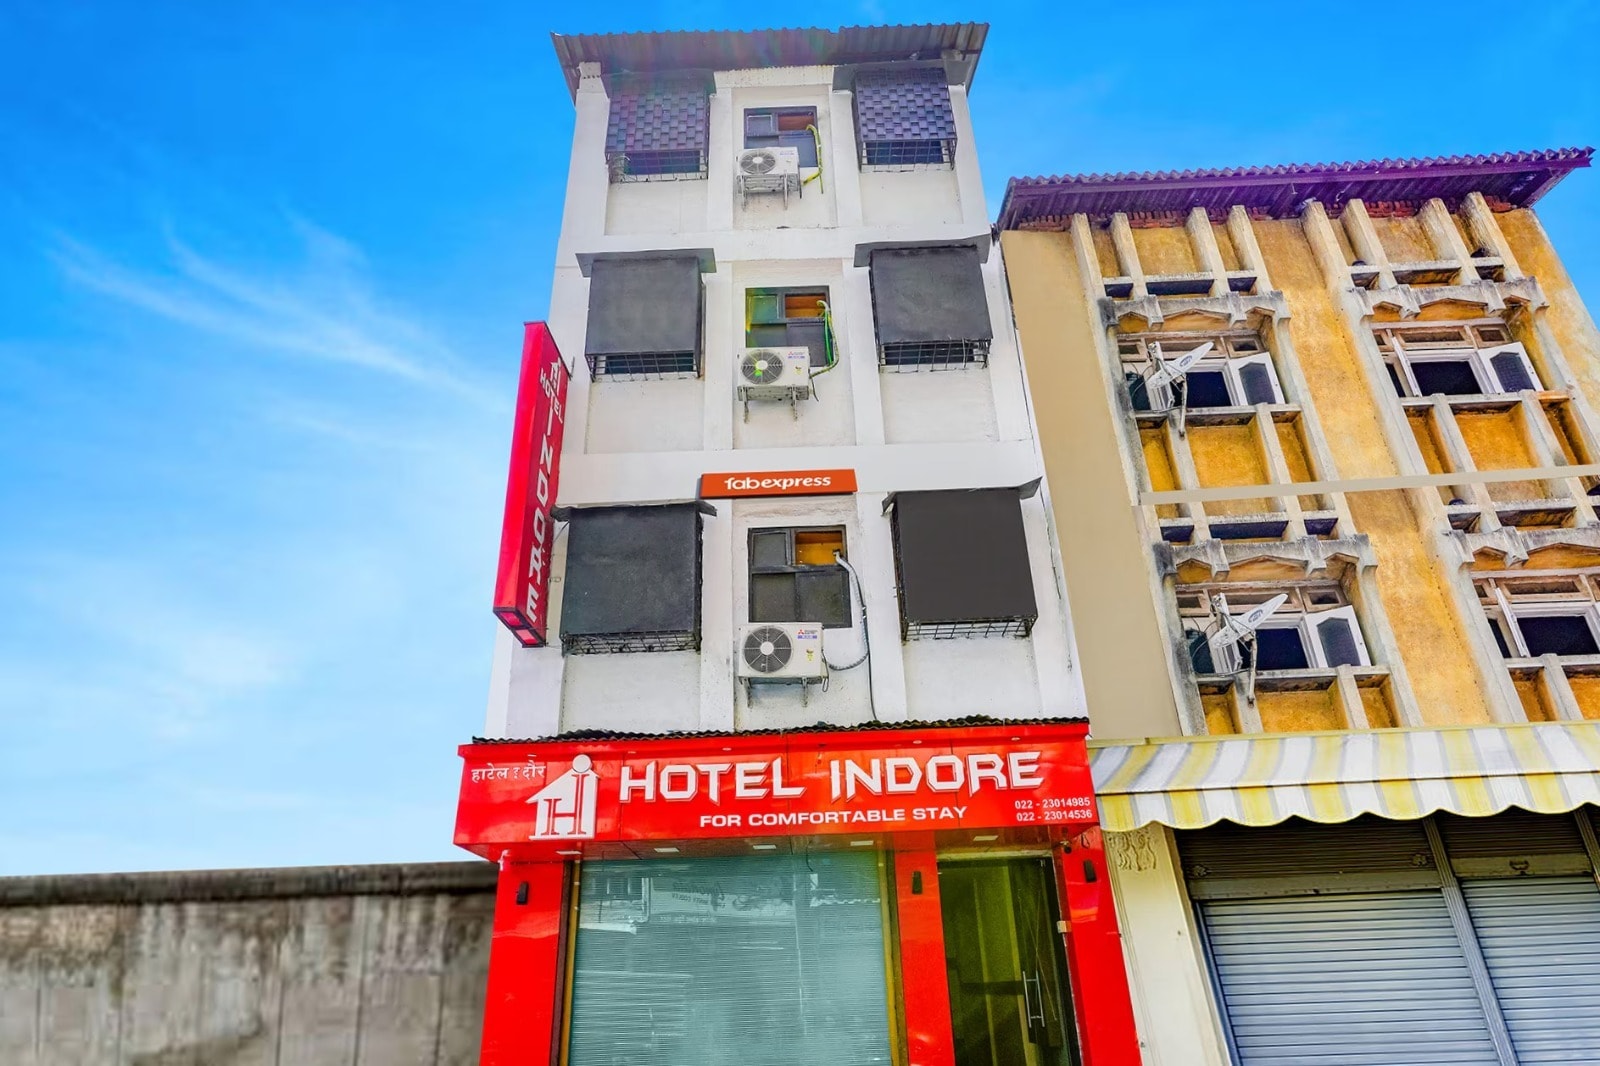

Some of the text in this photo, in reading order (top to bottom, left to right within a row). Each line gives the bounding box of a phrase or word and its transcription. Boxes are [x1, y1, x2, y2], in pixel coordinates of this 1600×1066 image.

[540, 367, 564, 424] HOTEL
[526, 407, 555, 623] INDORE
[619, 751, 1045, 806] HOTEL INDORE
[700, 806, 968, 828] FOR COMFORTABLE STAY
[1014, 799, 1034, 810] 022
[1042, 796, 1091, 809] 23014985
[1016, 811, 1036, 822] 022
[1044, 809, 1093, 821] 23014536
